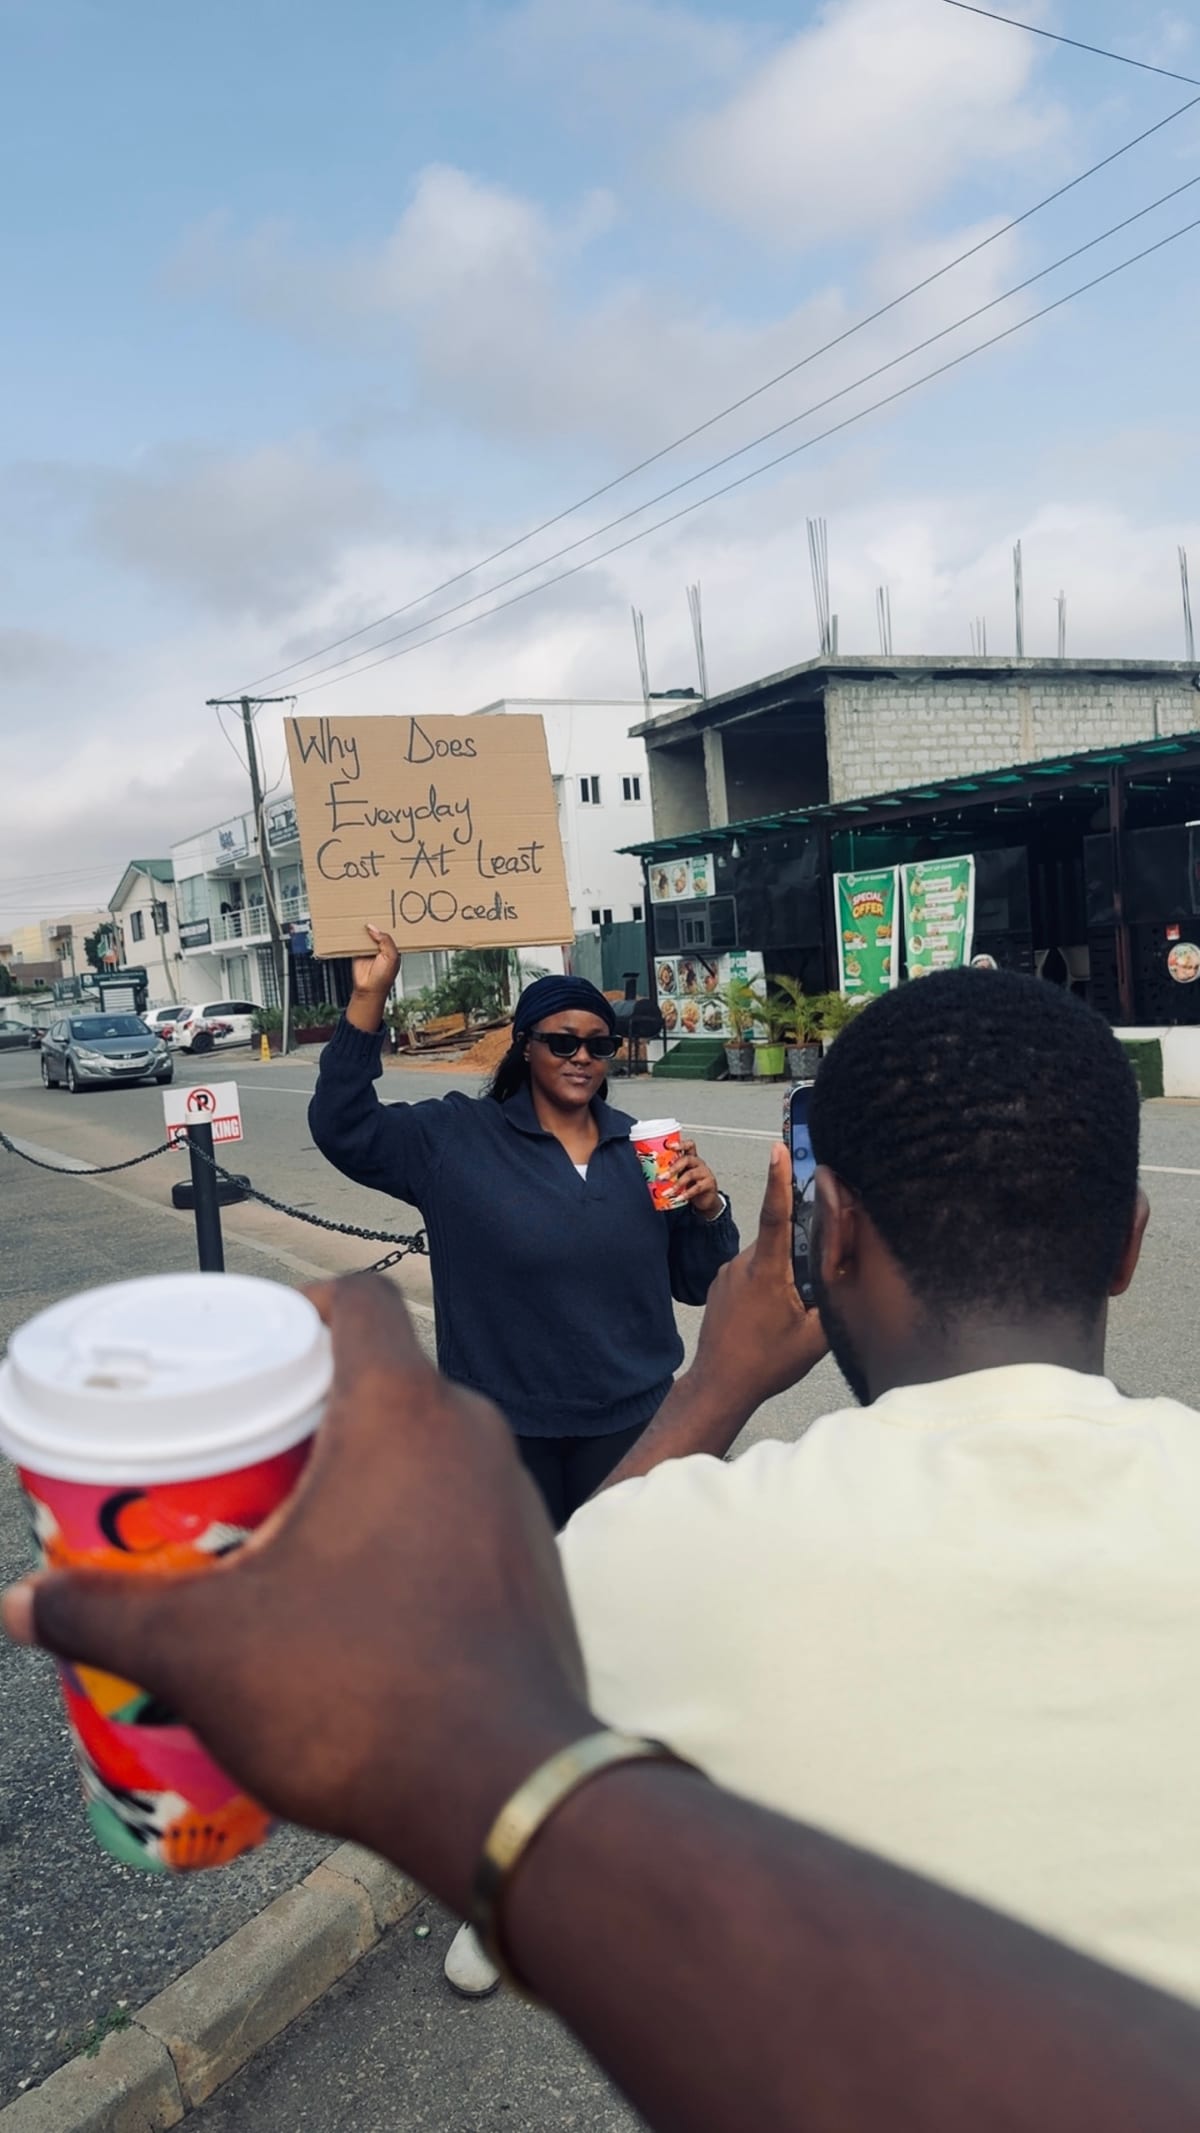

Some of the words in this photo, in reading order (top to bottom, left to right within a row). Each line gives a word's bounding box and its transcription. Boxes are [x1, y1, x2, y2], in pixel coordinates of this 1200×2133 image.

[292, 717, 361, 780] Why
[403, 717, 478, 763] Does
[325, 780, 473, 845] Everyday
[316, 838, 385, 881] Cost
[400, 840, 456, 880] At
[478, 839, 545, 879] Least
[852, 890, 882, 905] SPECIAL
[852, 902, 884, 918] OFFER
[211, 1118, 239, 1140] KING
